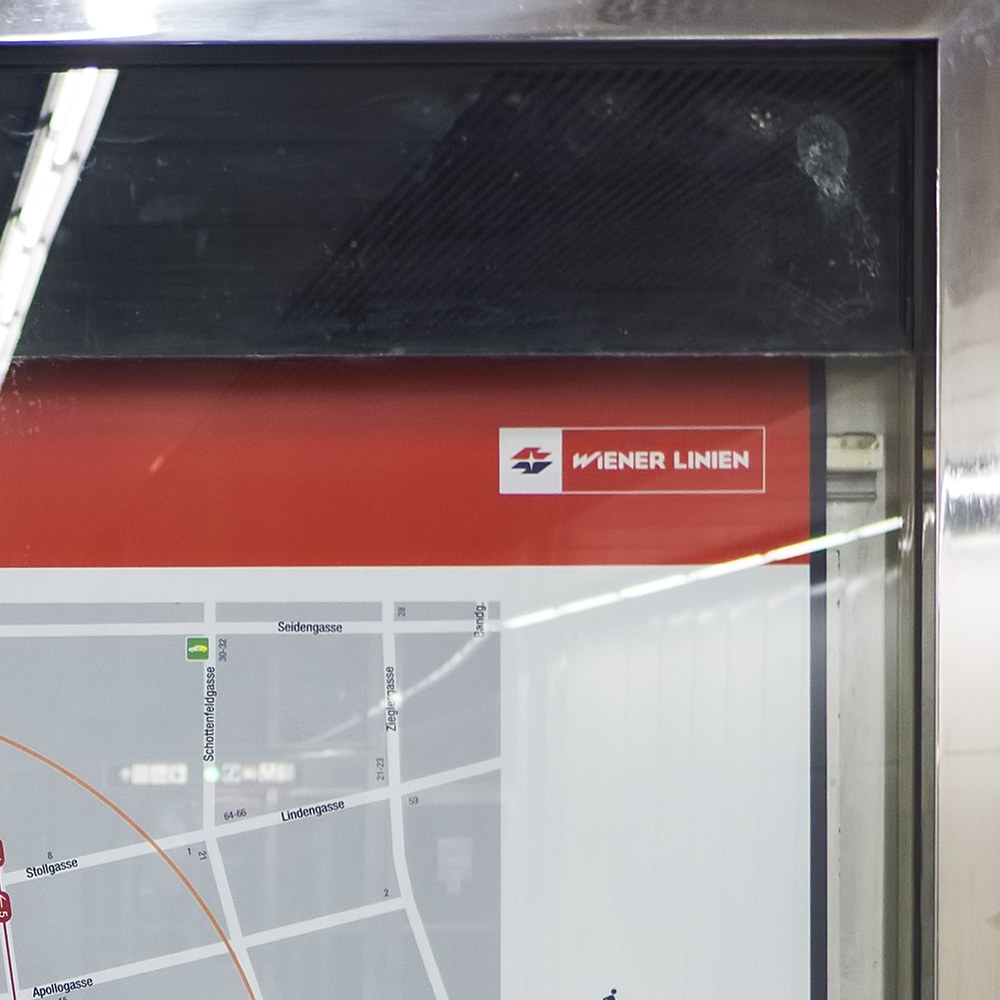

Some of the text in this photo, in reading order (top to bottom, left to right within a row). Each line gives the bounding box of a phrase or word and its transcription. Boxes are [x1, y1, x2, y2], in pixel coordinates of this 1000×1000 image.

[572, 451, 749, 470] WIENER LINIEN
[278, 621, 343, 634] Seidengasse
[219, 638, 227, 662] 30-32
[203, 667, 217, 762] Schottenfeldgasse
[376, 757, 385, 781] 21-23
[224, 808, 247, 821] 64-66
[281, 800, 345, 822] Lindengasse
[26, 858, 78, 879] Stollgasse
[32, 977, 93, 998] Apollogasse
